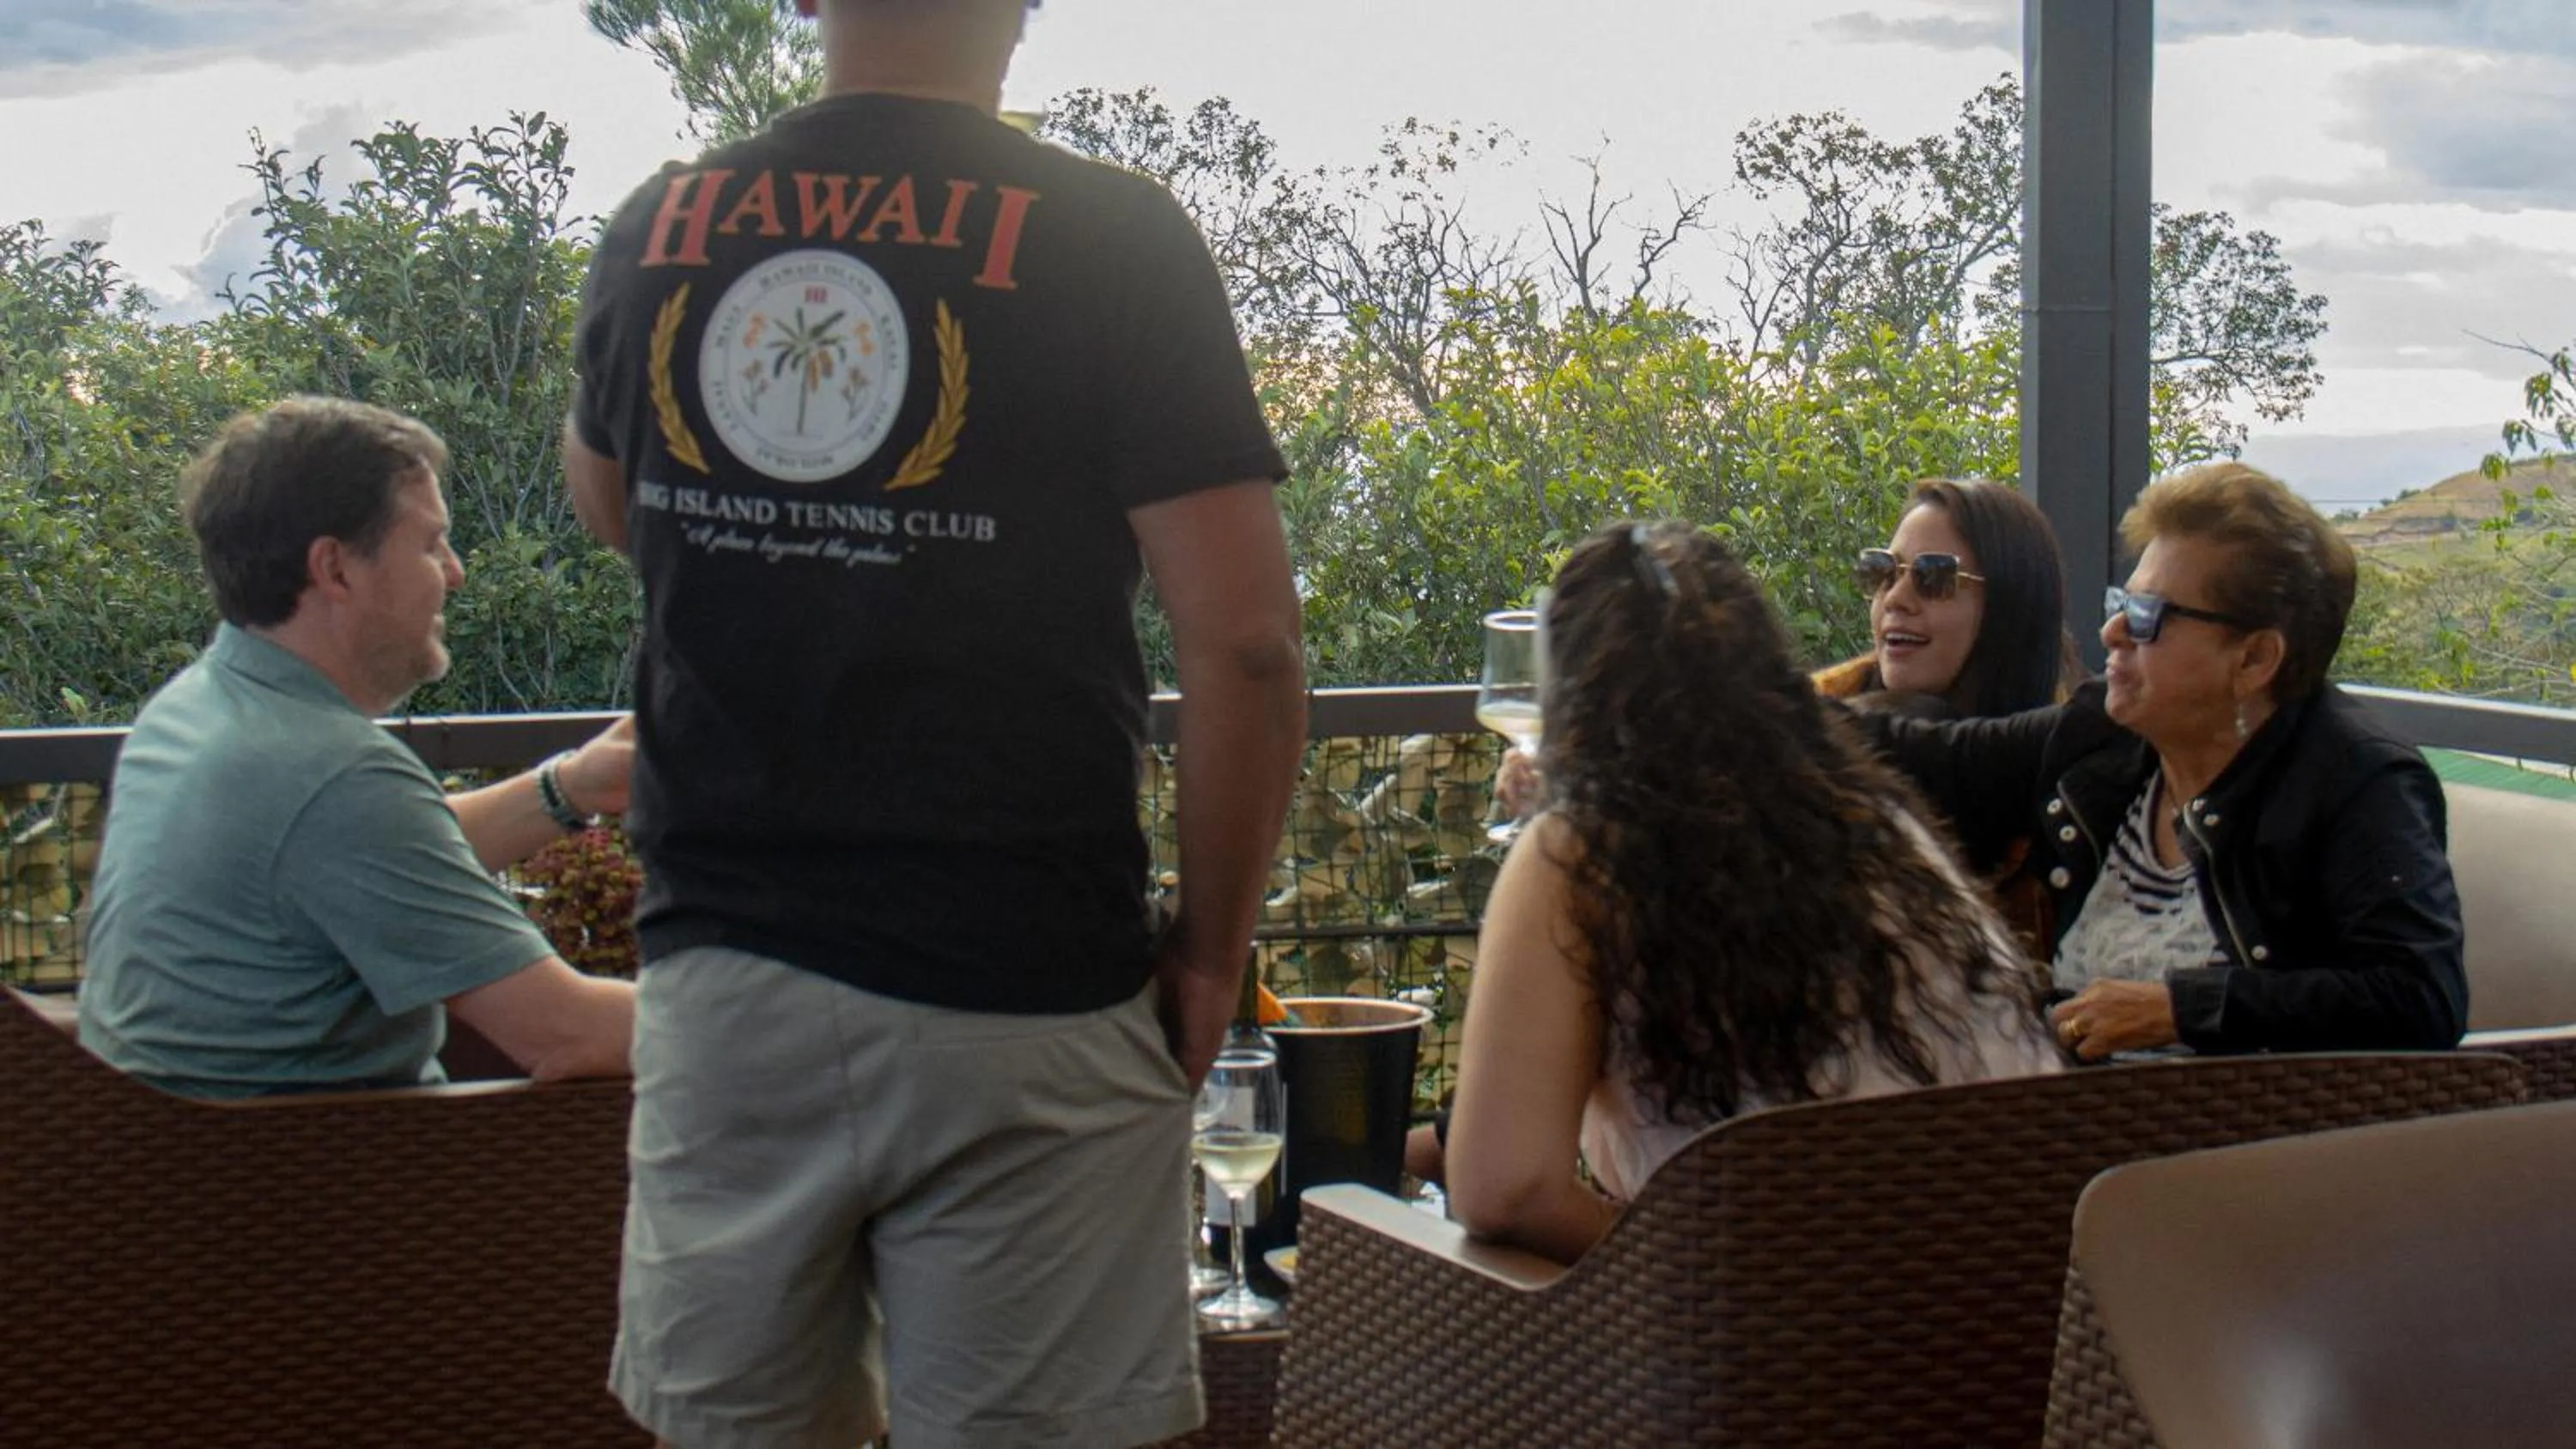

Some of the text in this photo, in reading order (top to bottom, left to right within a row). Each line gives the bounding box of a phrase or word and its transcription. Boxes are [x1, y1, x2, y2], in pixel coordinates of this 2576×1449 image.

[640, 168, 1042, 289] HAWAII
[674, 486, 778, 524] ISLAND
[784, 500, 896, 537] TENNIS
[902, 507, 998, 543] CLUB
